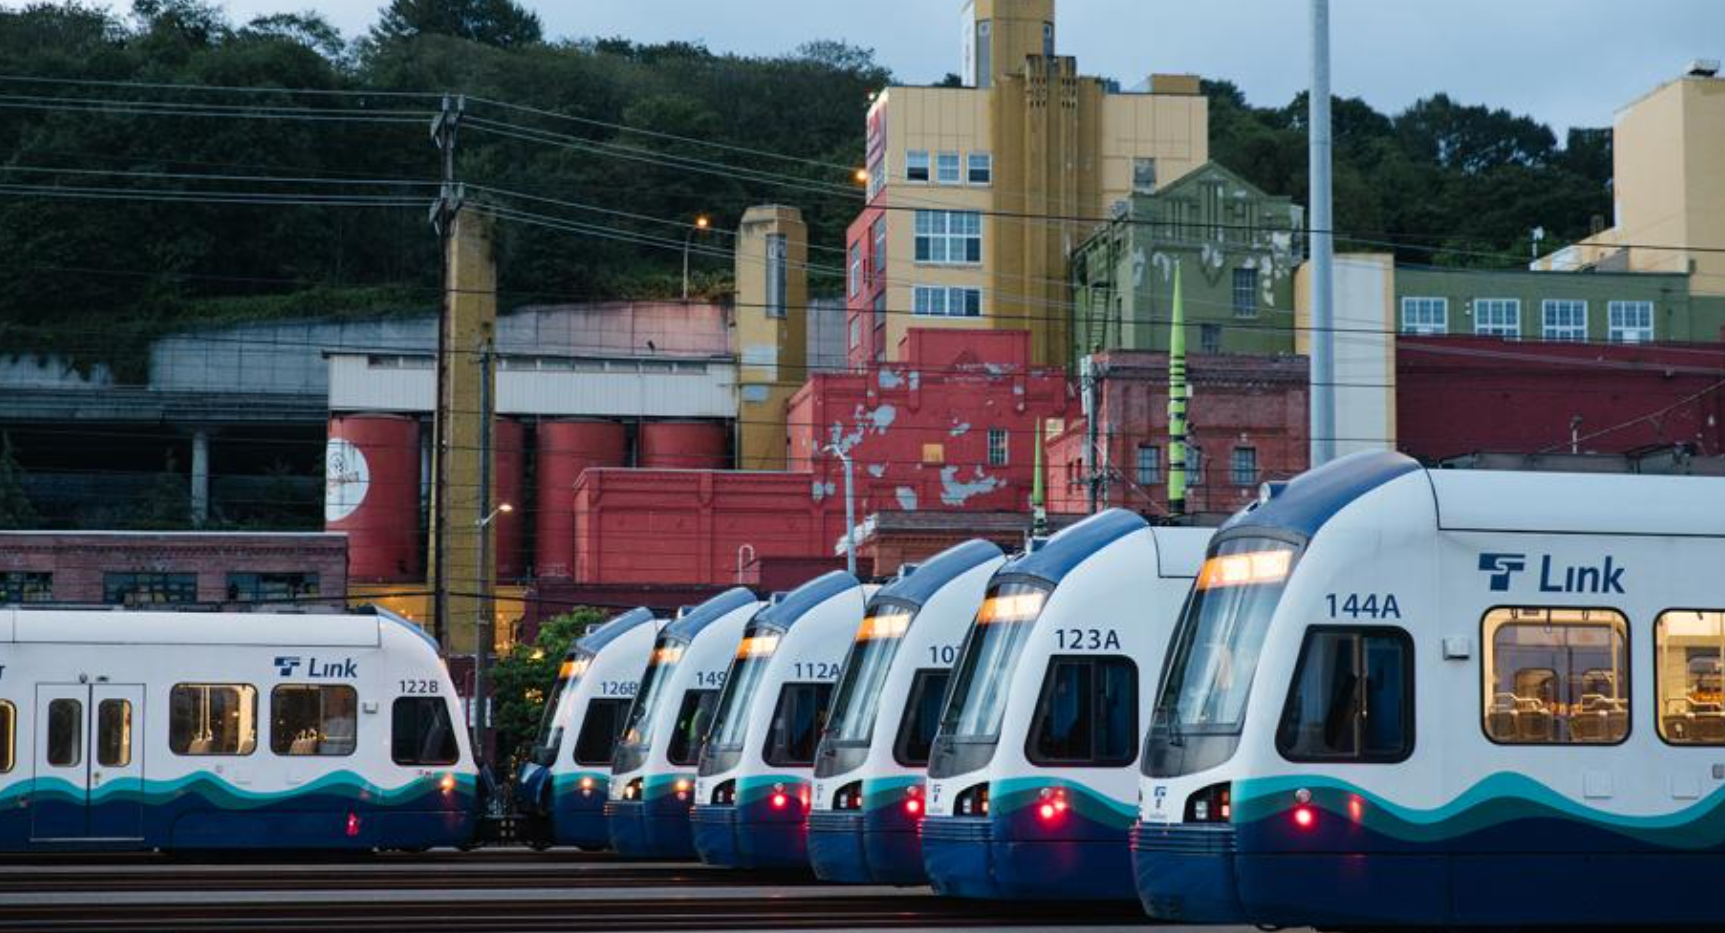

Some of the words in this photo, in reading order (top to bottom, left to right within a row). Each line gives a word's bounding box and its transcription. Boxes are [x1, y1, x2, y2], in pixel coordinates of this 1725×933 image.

[1539, 555, 1626, 594] Link
[1325, 593, 1401, 618] 144A
[1055, 629, 1121, 650] 123A
[308, 657, 358, 678] Link
[794, 663, 842, 678] 112A
[399, 680, 438, 693] 122B
